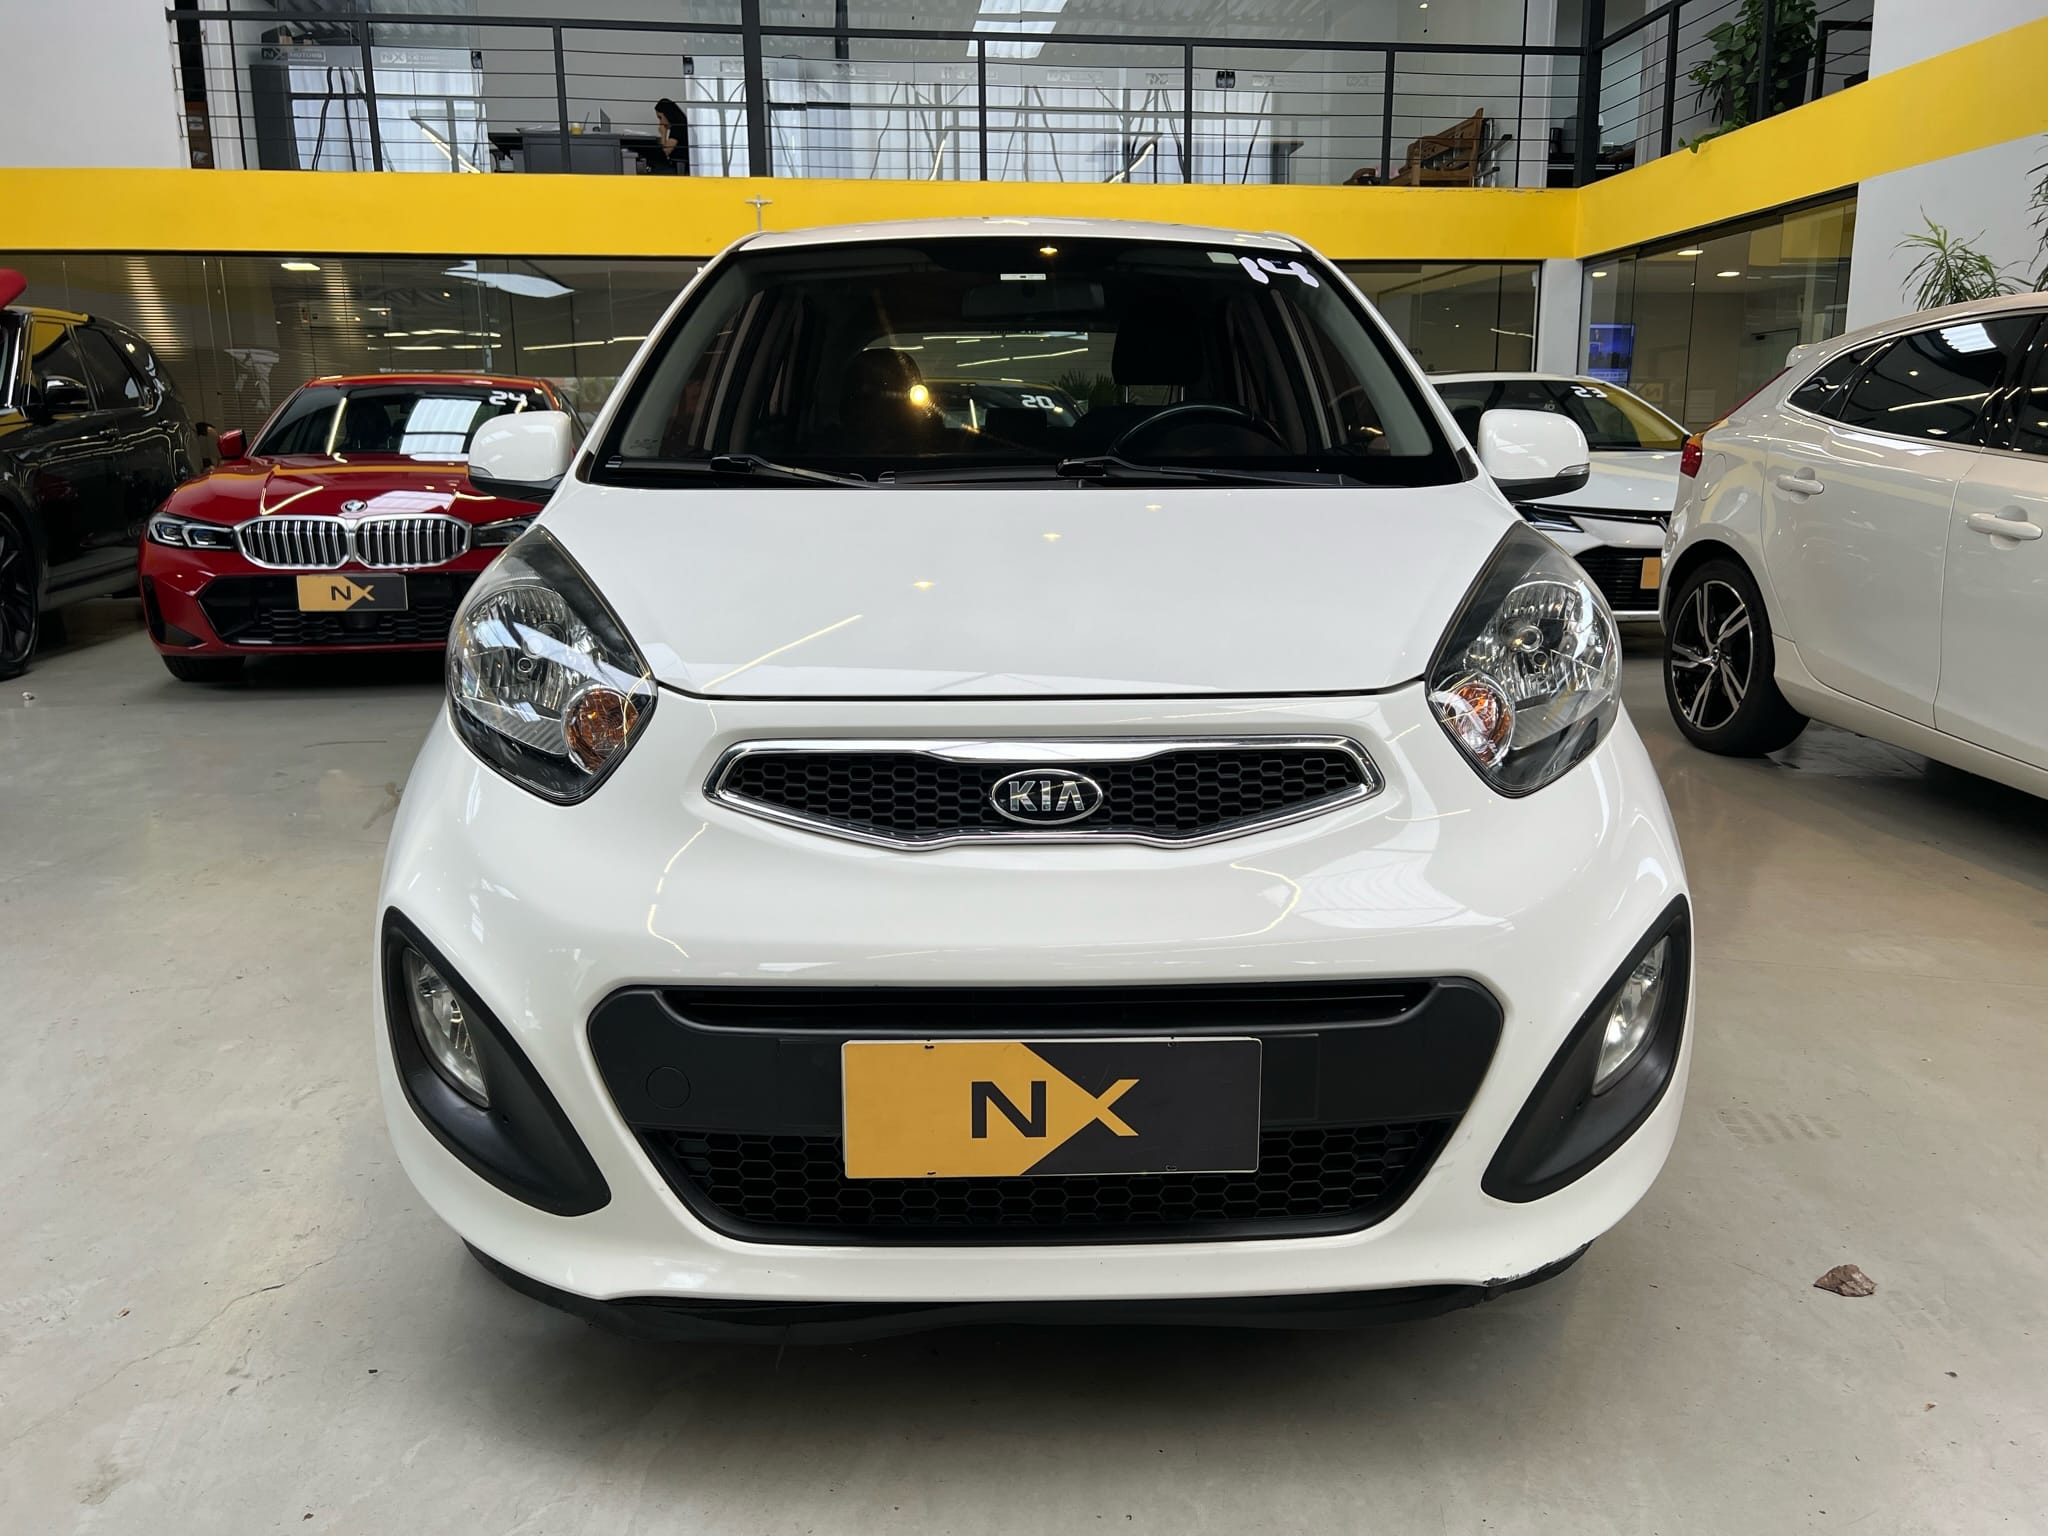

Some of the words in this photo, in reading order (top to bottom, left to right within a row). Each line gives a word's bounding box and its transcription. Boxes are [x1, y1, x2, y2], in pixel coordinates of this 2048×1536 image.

[1239, 257, 1319, 288] 14
[489, 390, 528, 407] 24
[1020, 394, 1055, 409] 20
[331, 585, 375, 601] NX
[1009, 780, 1085, 811] KIA
[971, 1078, 1140, 1138] NX
